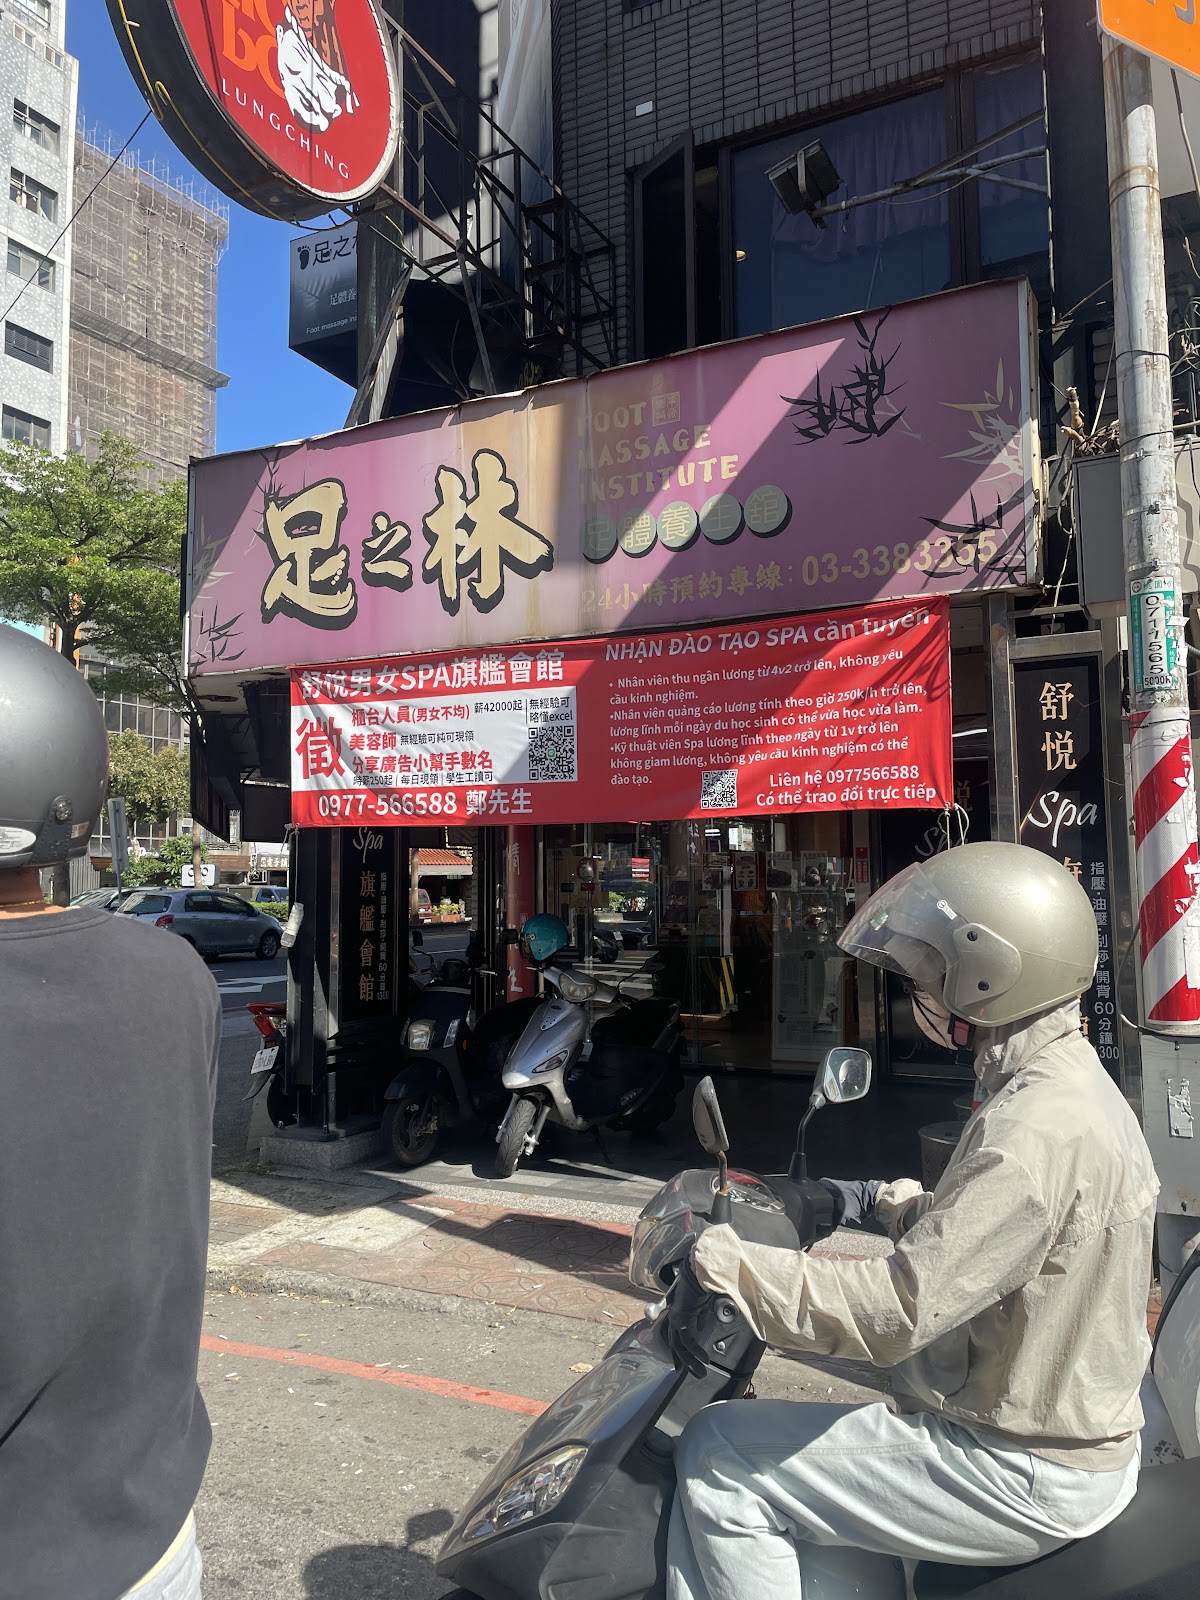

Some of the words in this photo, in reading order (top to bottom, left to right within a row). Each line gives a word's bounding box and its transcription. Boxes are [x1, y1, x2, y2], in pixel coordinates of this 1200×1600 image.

[222, 78, 349, 178] LUNGCHING
[312, 233, 358, 267] 足之
[306, 325, 321, 335] Foot
[321, 318, 348, 331] massage
[261, 447, 554, 630] 足之林
[802, 531, 997, 586] 03-3383355
[604, 638, 662, 664] NHẬN
[668, 632, 712, 656] ĐÀO
[718, 630, 760, 656] TẠO
[766, 628, 808, 648] SPA
[813, 618, 856, 644] cần
[617, 675, 644, 688] Nhân
[647, 674, 670, 686] viên
[671, 673, 690, 685] thu
[692, 669, 720, 685] ngân
[722, 668, 755, 682] lương
[756, 666, 770, 678] từ
[770, 663, 792, 676] 4v2
[813, 657, 837, 672] lên,
[839, 653, 879, 668] không
[881, 649, 904, 664] yêu
[474, 699, 523, 714] 薪42000起
[529, 696, 570, 710] 無經驗可
[610, 692, 628, 706] cầu
[630, 692, 653, 704] kinh
[656, 688, 699, 704] nghiệm.
[643, 706, 665, 720] viên
[667, 704, 701, 720] quảng
[702, 702, 722, 715] cáo
[724, 701, 756, 715] lương
[758, 697, 782, 711] tính
[784, 696, 813, 709] theo
[815, 693, 836, 709] giờ
[836, 686, 878, 703] 250k/h
[880, 684, 900, 698] trở
[902, 682, 927, 697] lên,
[529, 710, 573, 724] 略懂excel
[610, 725, 640, 738] lương
[641, 722, 661, 735] lĩnh
[664, 720, 684, 734] mỗi
[686, 721, 712, 734] ngày
[714, 718, 728, 730] du
[731, 717, 751, 732] học
[754, 715, 779, 728] sinh
[781, 713, 796, 727] có
[798, 709, 819, 724] thể
[820, 706, 840, 721] vừa
[842, 705, 866, 721] học
[868, 702, 892, 716] vừa
[894, 701, 923, 714] làm.
[295, 716, 346, 780] 徵
[350, 732, 397, 751] 美容師
[610, 757, 642, 771] không
[644, 756, 671, 770] giam
[672, 754, 708, 767] lương,
[709, 752, 746, 766] không
[747, 750, 768, 763] yêu
[769, 746, 789, 760] cầu
[792, 745, 819, 758] kinh
[821, 741, 868, 757] nghiệm
[870, 738, 885, 752] có
[887, 735, 909, 750] thể
[629, 740, 657, 754] thuật
[659, 738, 682, 750] viên
[683, 739, 704, 752] Spa
[706, 736, 739, 750] lương
[740, 734, 764, 746] lĩnh
[765, 732, 792, 745] theo
[794, 727, 821, 743] ngày
[824, 725, 838, 738] từ
[840, 726, 855, 737] 1v
[857, 721, 877, 735] trở
[879, 720, 899, 733] lên
[352, 750, 493, 774] 分享廣告小幫手數名
[769, 772, 801, 788] Liên
[804, 770, 824, 788] hệ
[825, 765, 920, 784] 0977566588
[400, 774, 439, 786] 每日現領
[610, 773, 630, 786] đào
[632, 774, 652, 787] tạo.
[756, 791, 775, 807] Có
[777, 789, 802, 805] thể
[805, 790, 837, 804] trao
[840, 785, 864, 802] đổi
[866, 784, 900, 804] trực
[903, 782, 937, 803] tiếp
[318, 791, 458, 817] 0977-566588
[466, 787, 533, 815] 鄭先生
[1028, 790, 1098, 848] Spa
[353, 826, 384, 864] Spa
